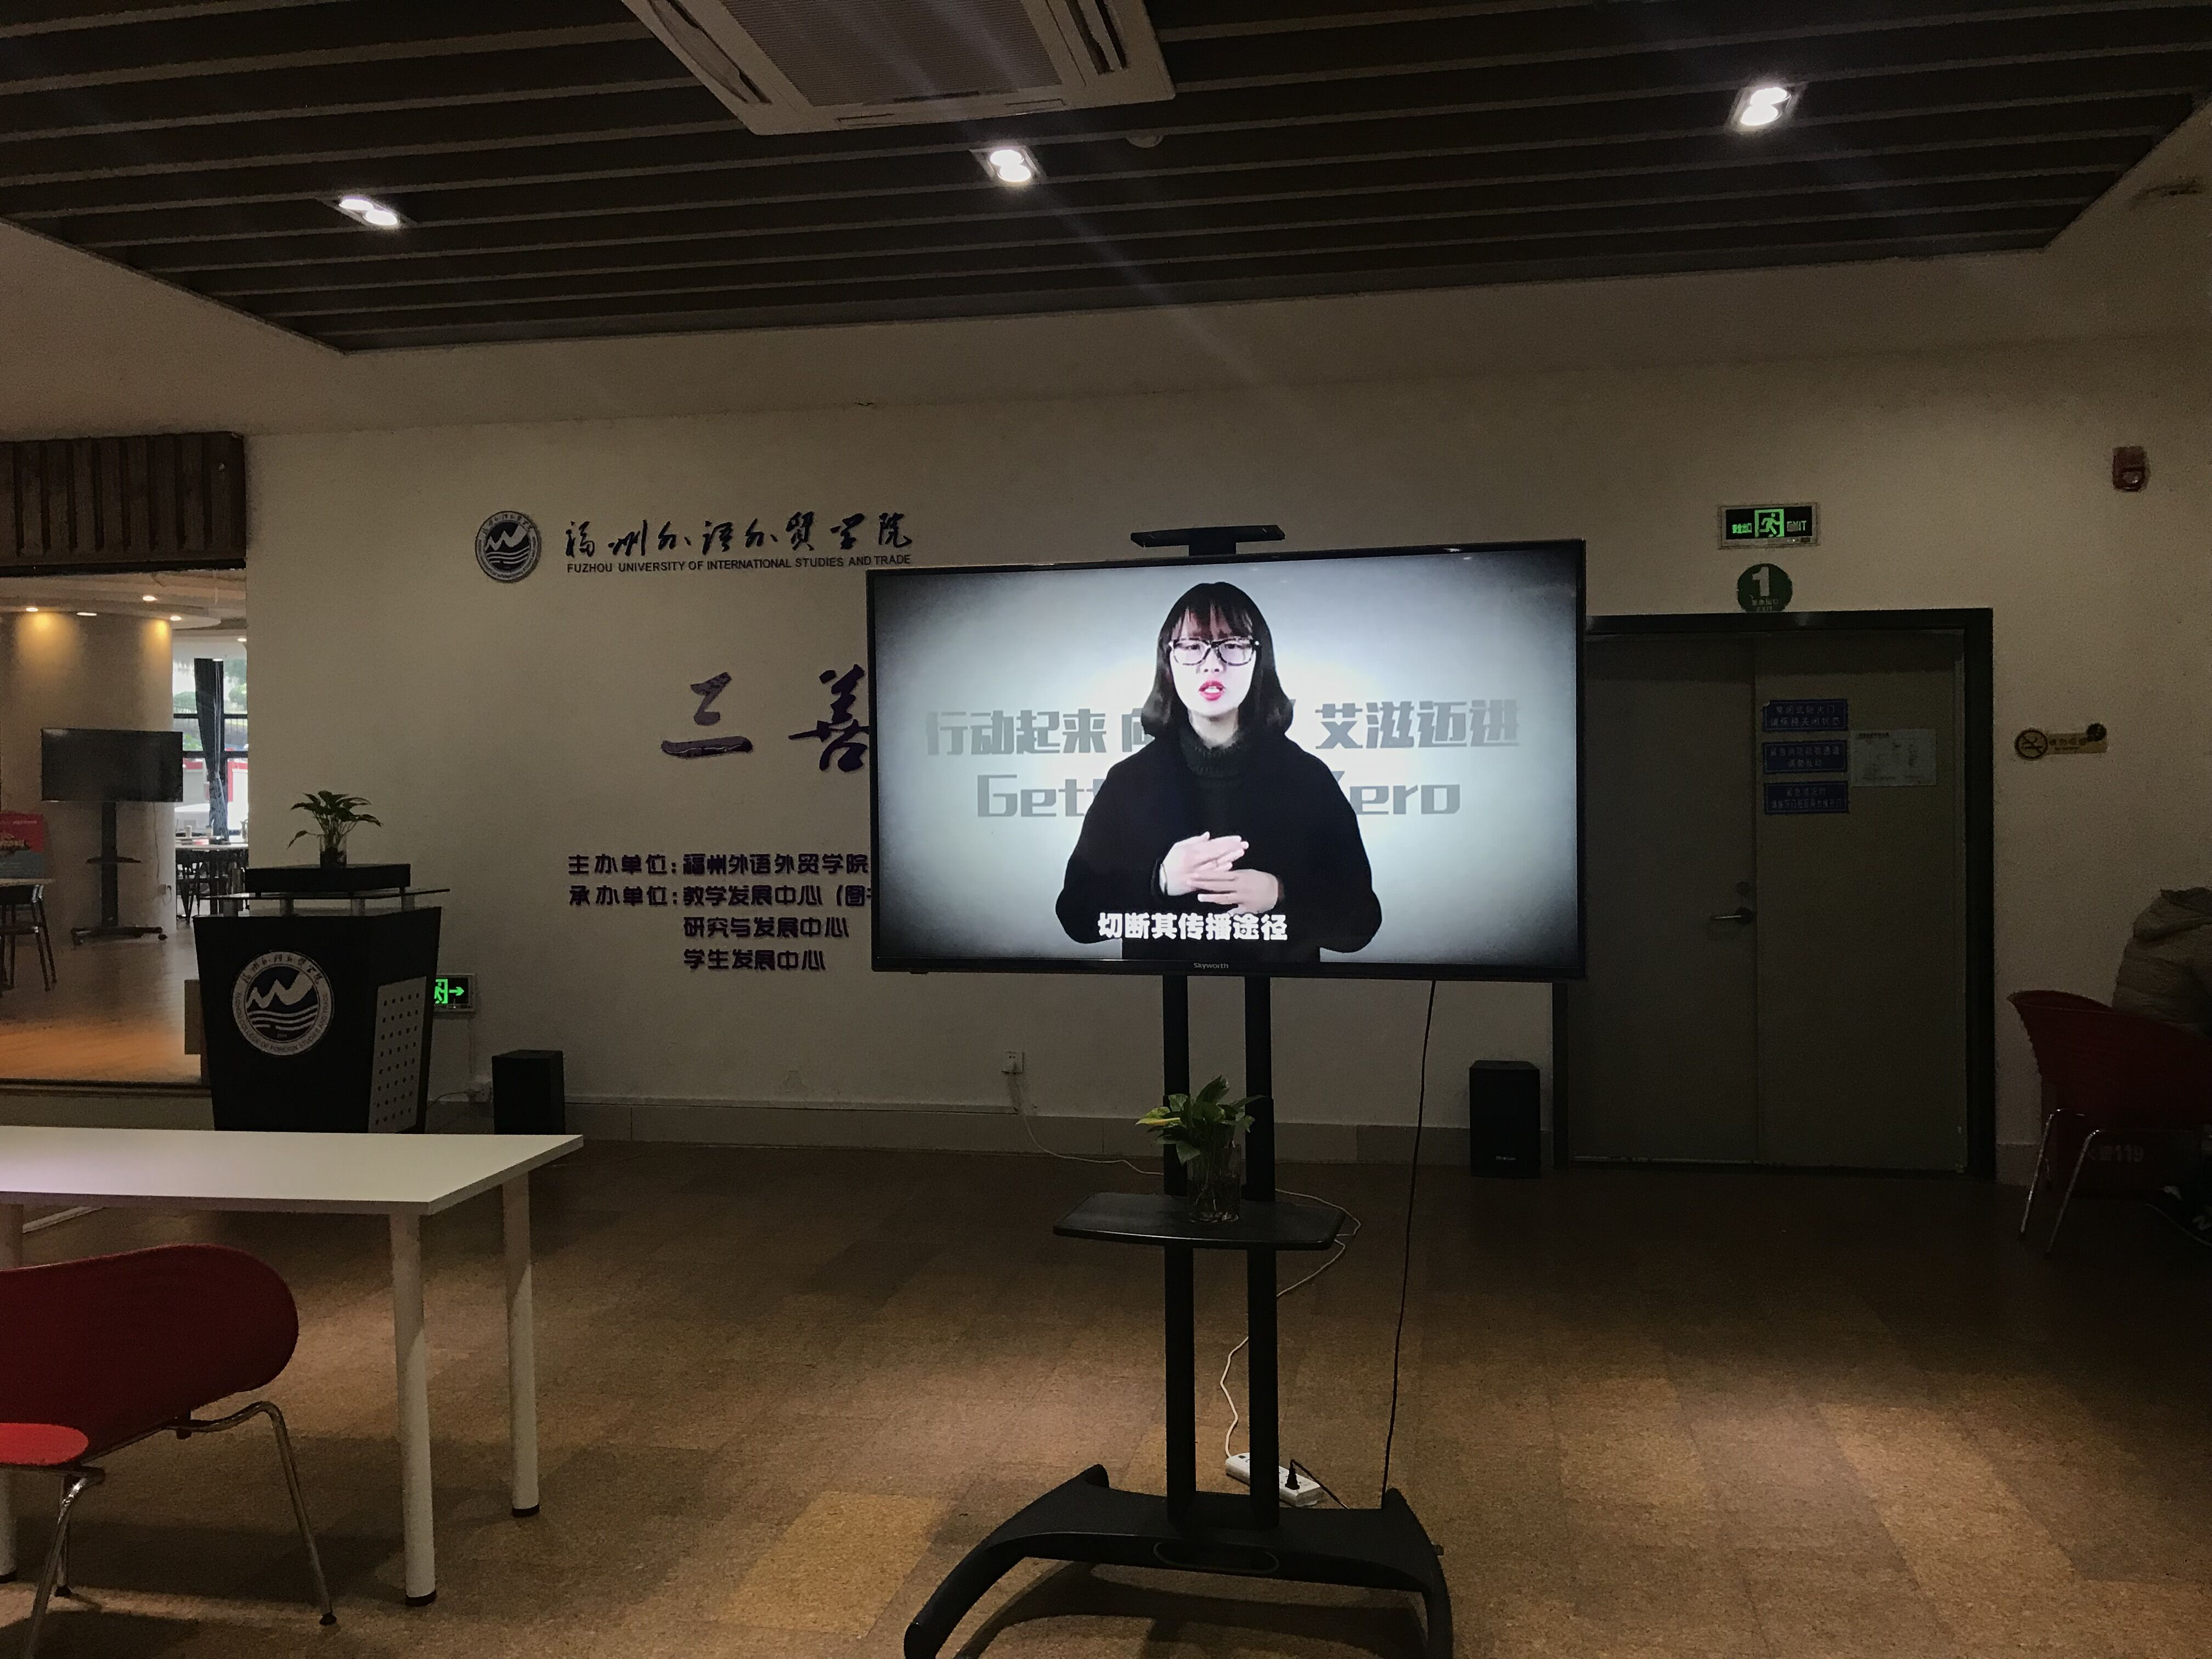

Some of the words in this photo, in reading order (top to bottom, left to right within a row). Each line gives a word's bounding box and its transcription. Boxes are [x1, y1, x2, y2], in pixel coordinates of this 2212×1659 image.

[567, 563, 613, 573] FUZHOU
[618, 561, 685, 573] UNIVERSITY
[688, 561, 703, 571] OF
[707, 558, 792, 571] INTERNATIONAL
[795, 557, 844, 568] STUDIES
[848, 556, 871, 566] AND
[874, 555, 911, 565] TRADE
[1752, 566, 1770, 597] 1
[926, 708, 1107, 755] 行动起来
[683, 916, 849, 938] 研究与发展中心
[1097, 912, 1288, 940] 切断其传播途径
[683, 949, 826, 970] 学生发展中心
[1193, 962, 1229, 970] Skyworth
